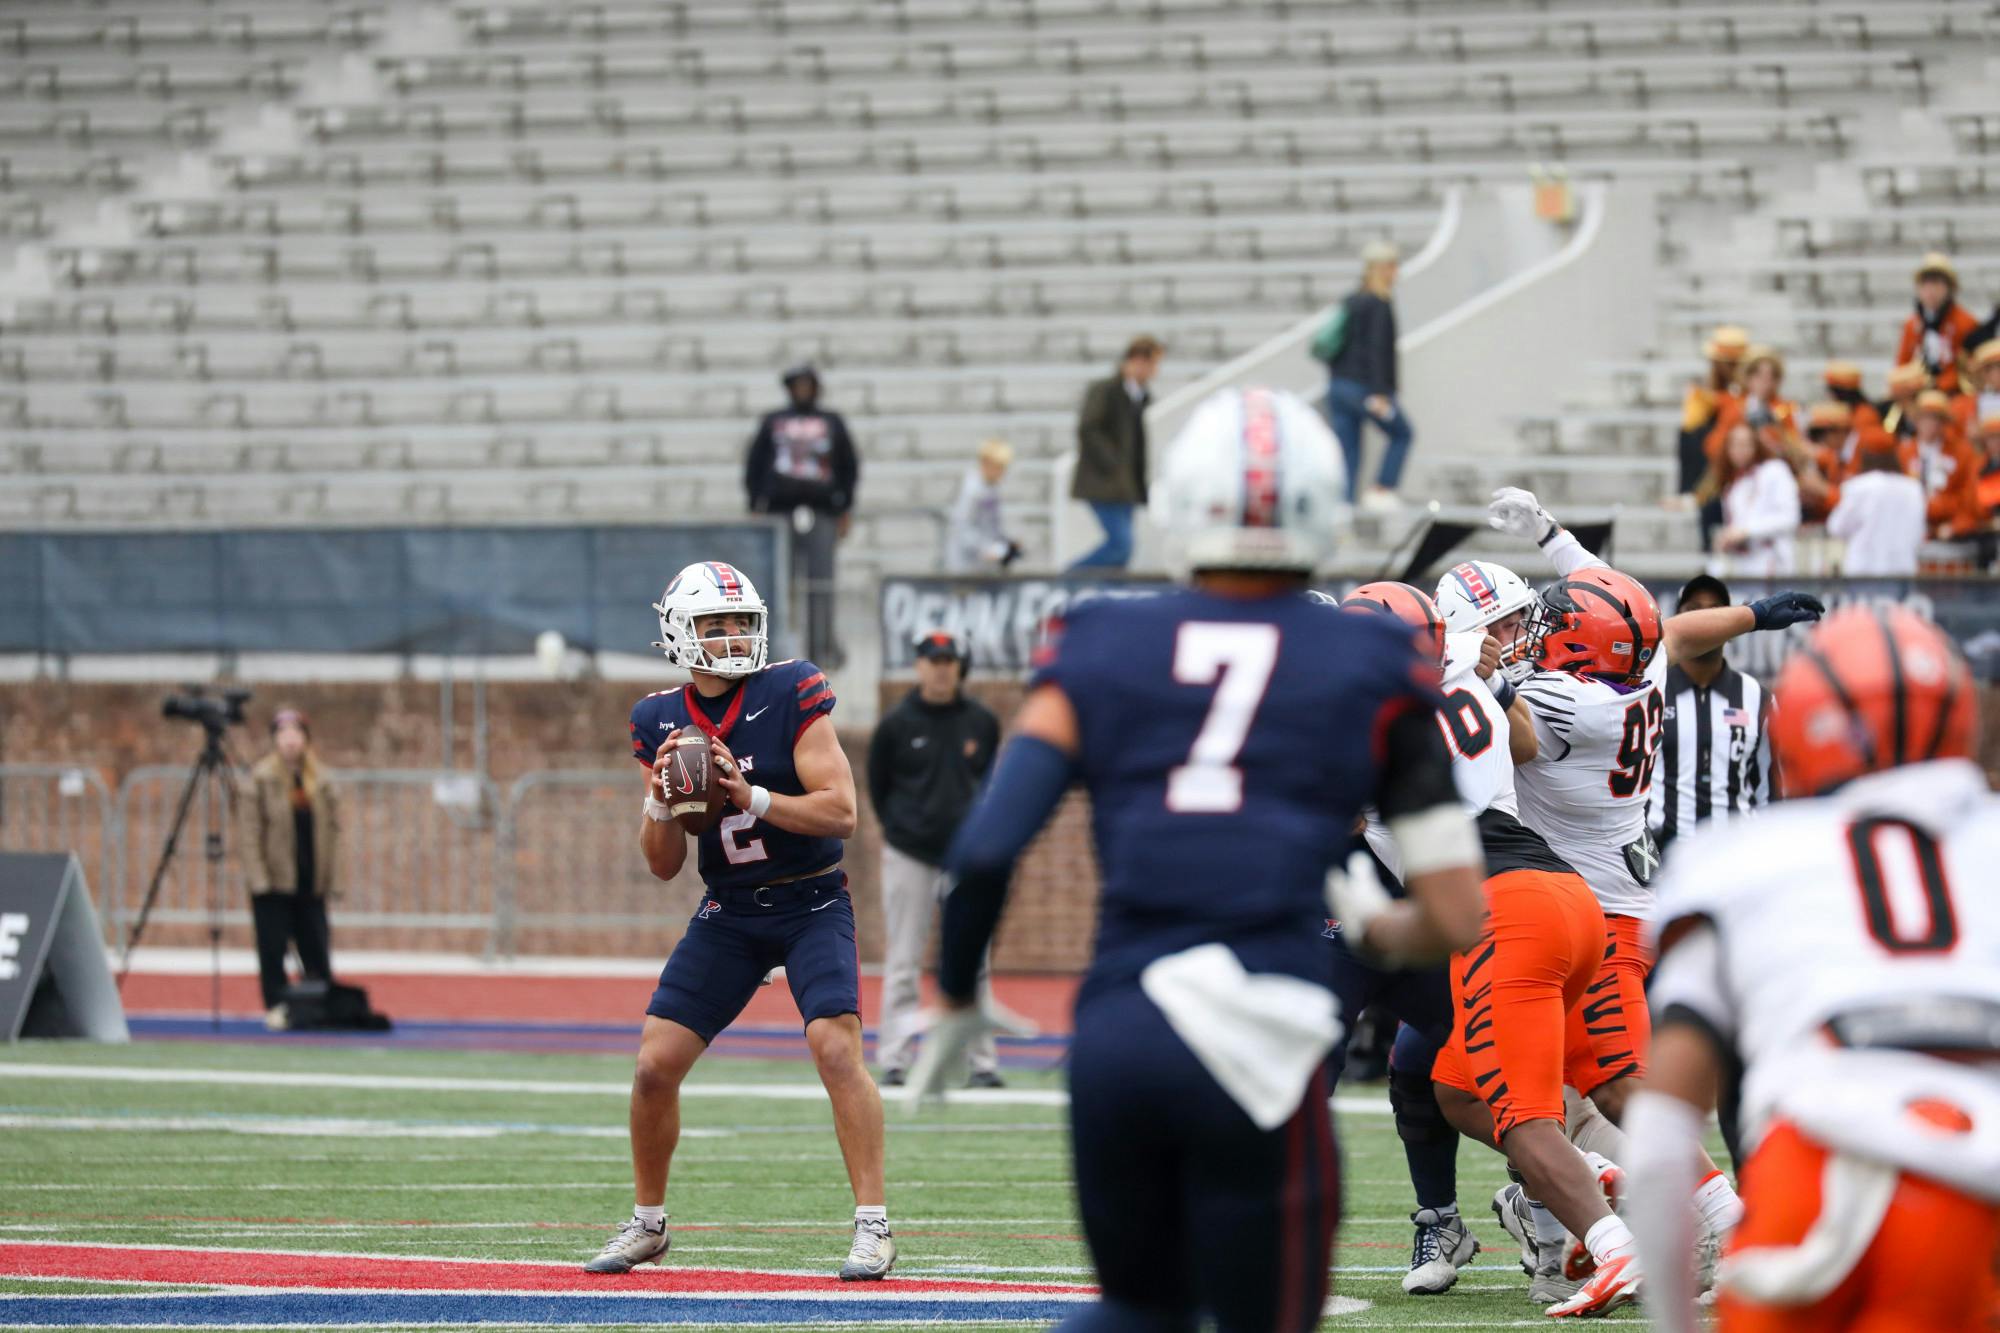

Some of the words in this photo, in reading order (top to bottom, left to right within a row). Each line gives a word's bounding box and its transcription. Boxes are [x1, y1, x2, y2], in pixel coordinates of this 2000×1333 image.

[1484, 604, 1501, 616] PENN
[1164, 619, 1283, 815] 7
[1608, 686, 1664, 798] 92
[720, 808, 769, 865] 2
[1845, 812, 1959, 957] 0
